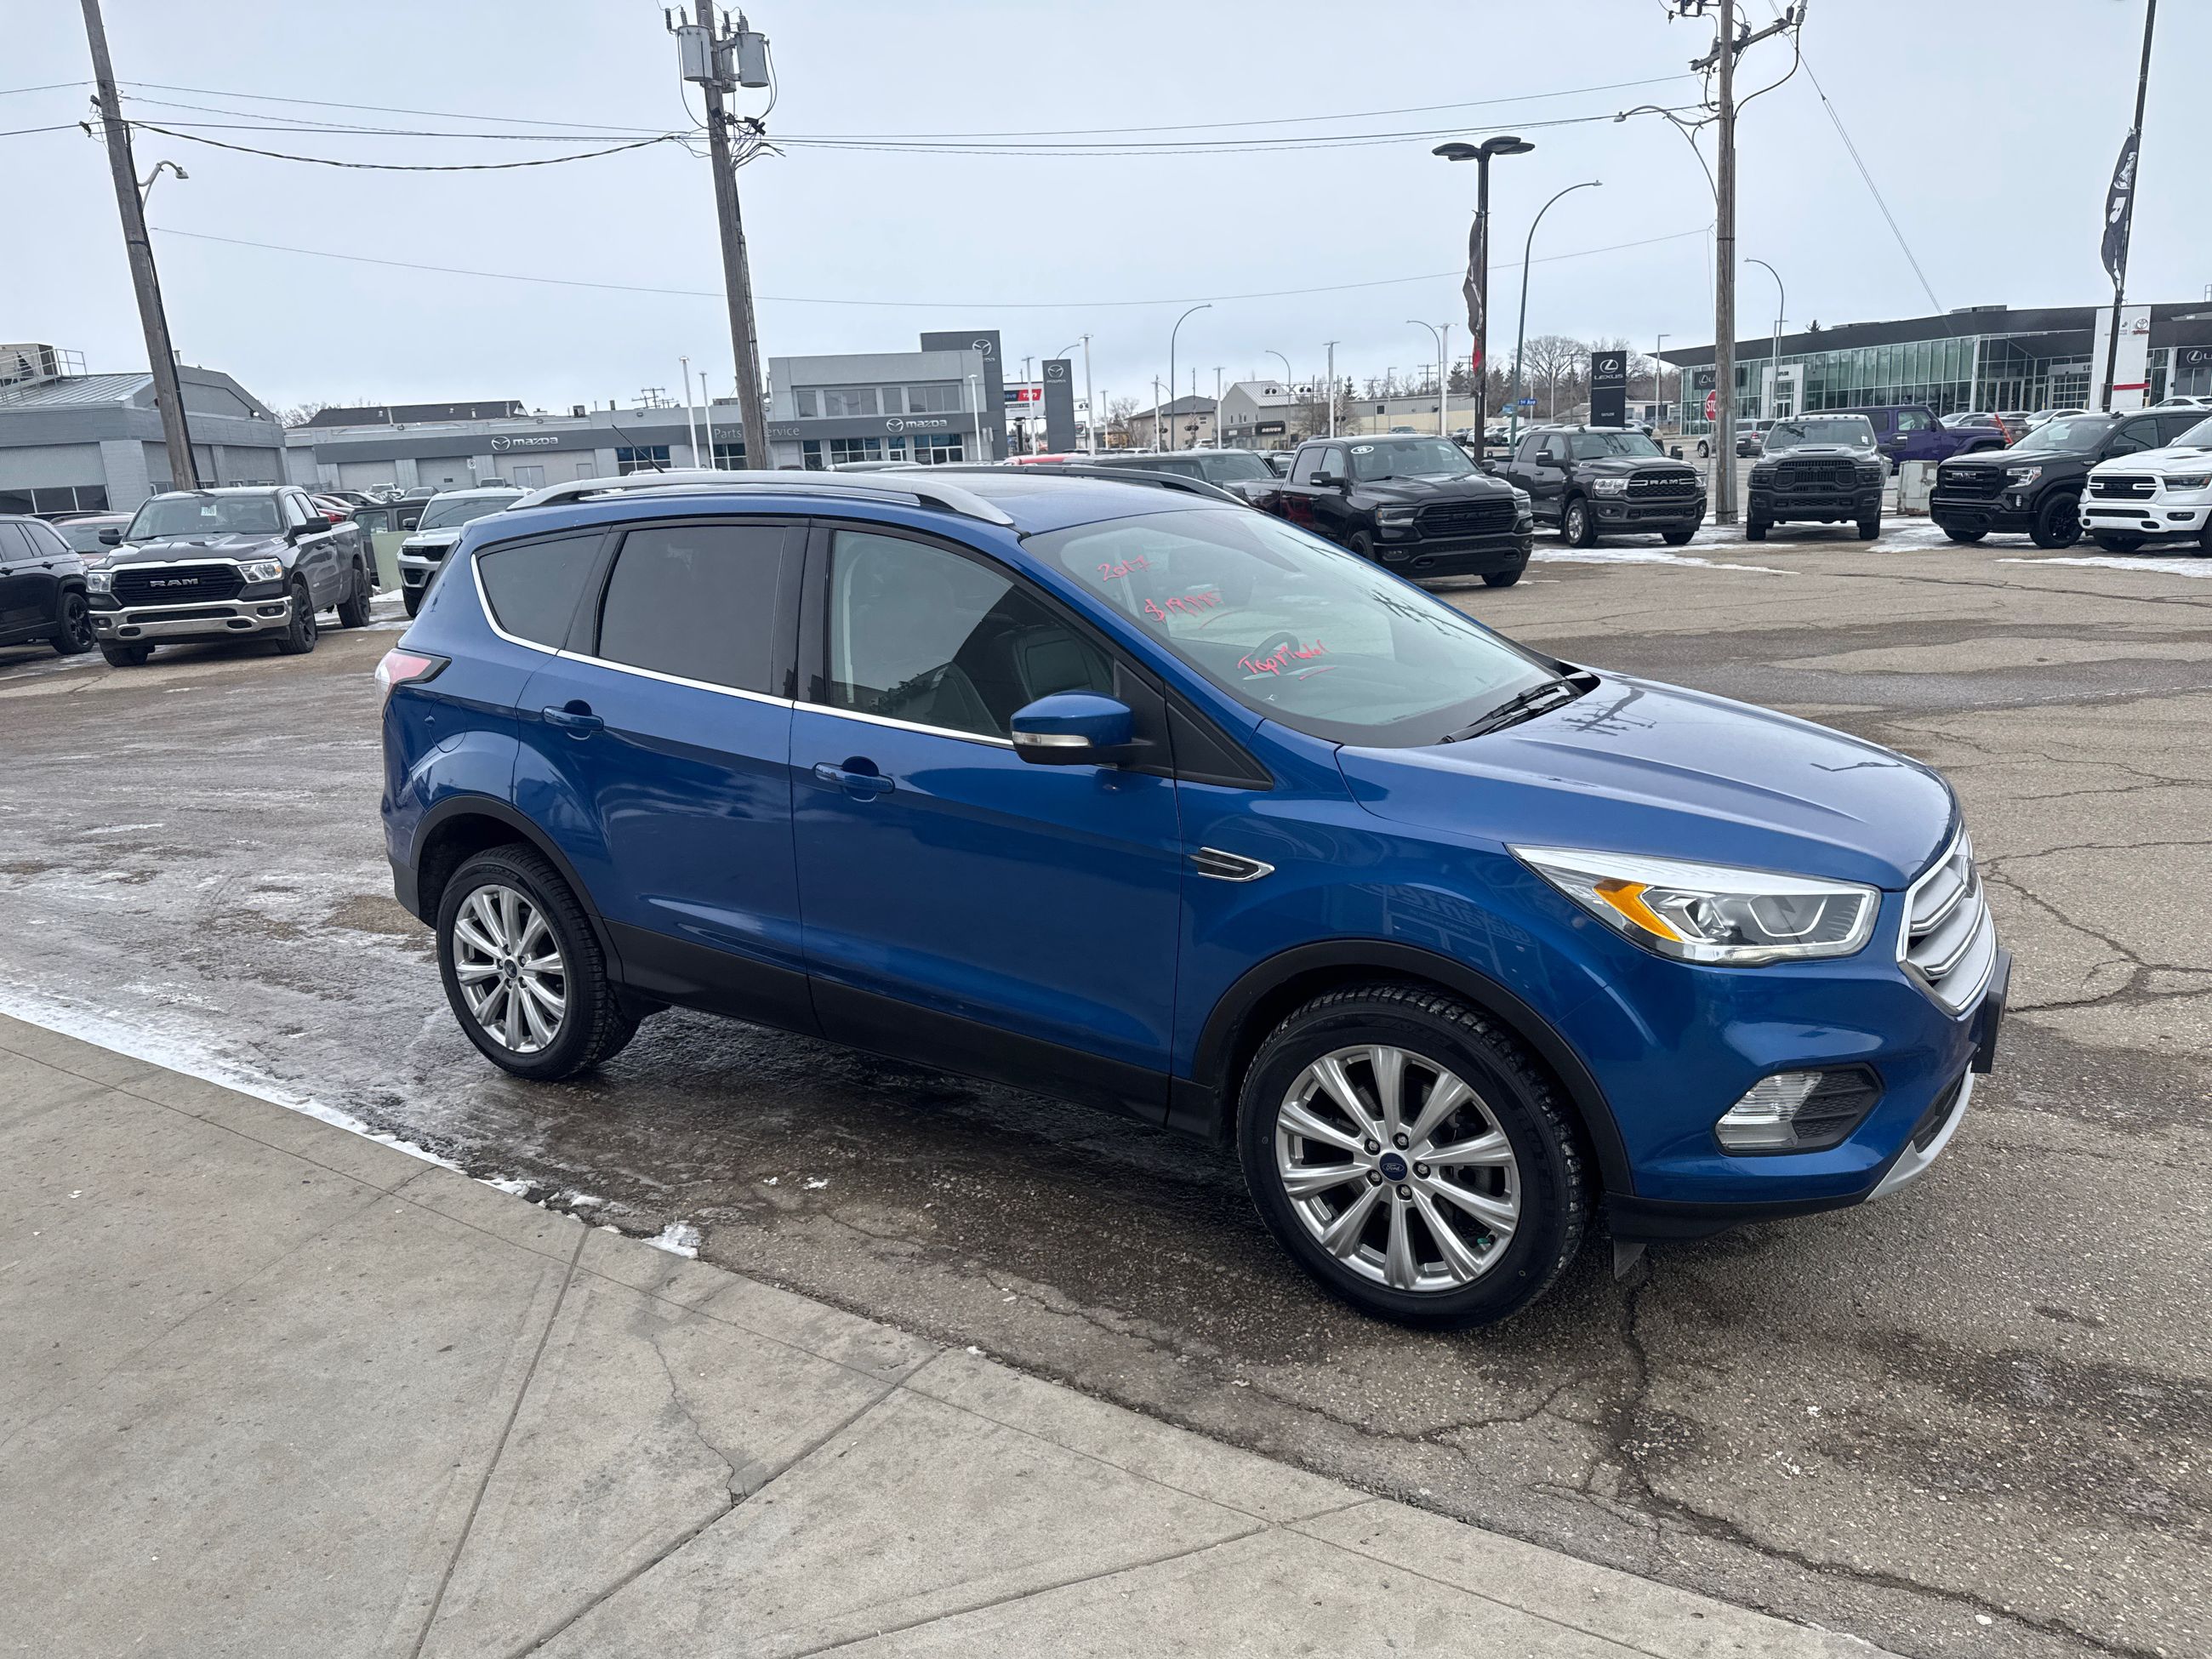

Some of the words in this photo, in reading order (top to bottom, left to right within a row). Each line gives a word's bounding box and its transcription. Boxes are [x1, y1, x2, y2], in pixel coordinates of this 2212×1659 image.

[1707, 400, 1716, 412] STO
[905, 419, 948, 428] mazda
[714, 428, 742, 439] Parts
[765, 426, 800, 437] ervice
[512, 436, 558, 446] mazda
[1097, 555, 1152, 582] 2017
[150, 578, 198, 587] RAM
